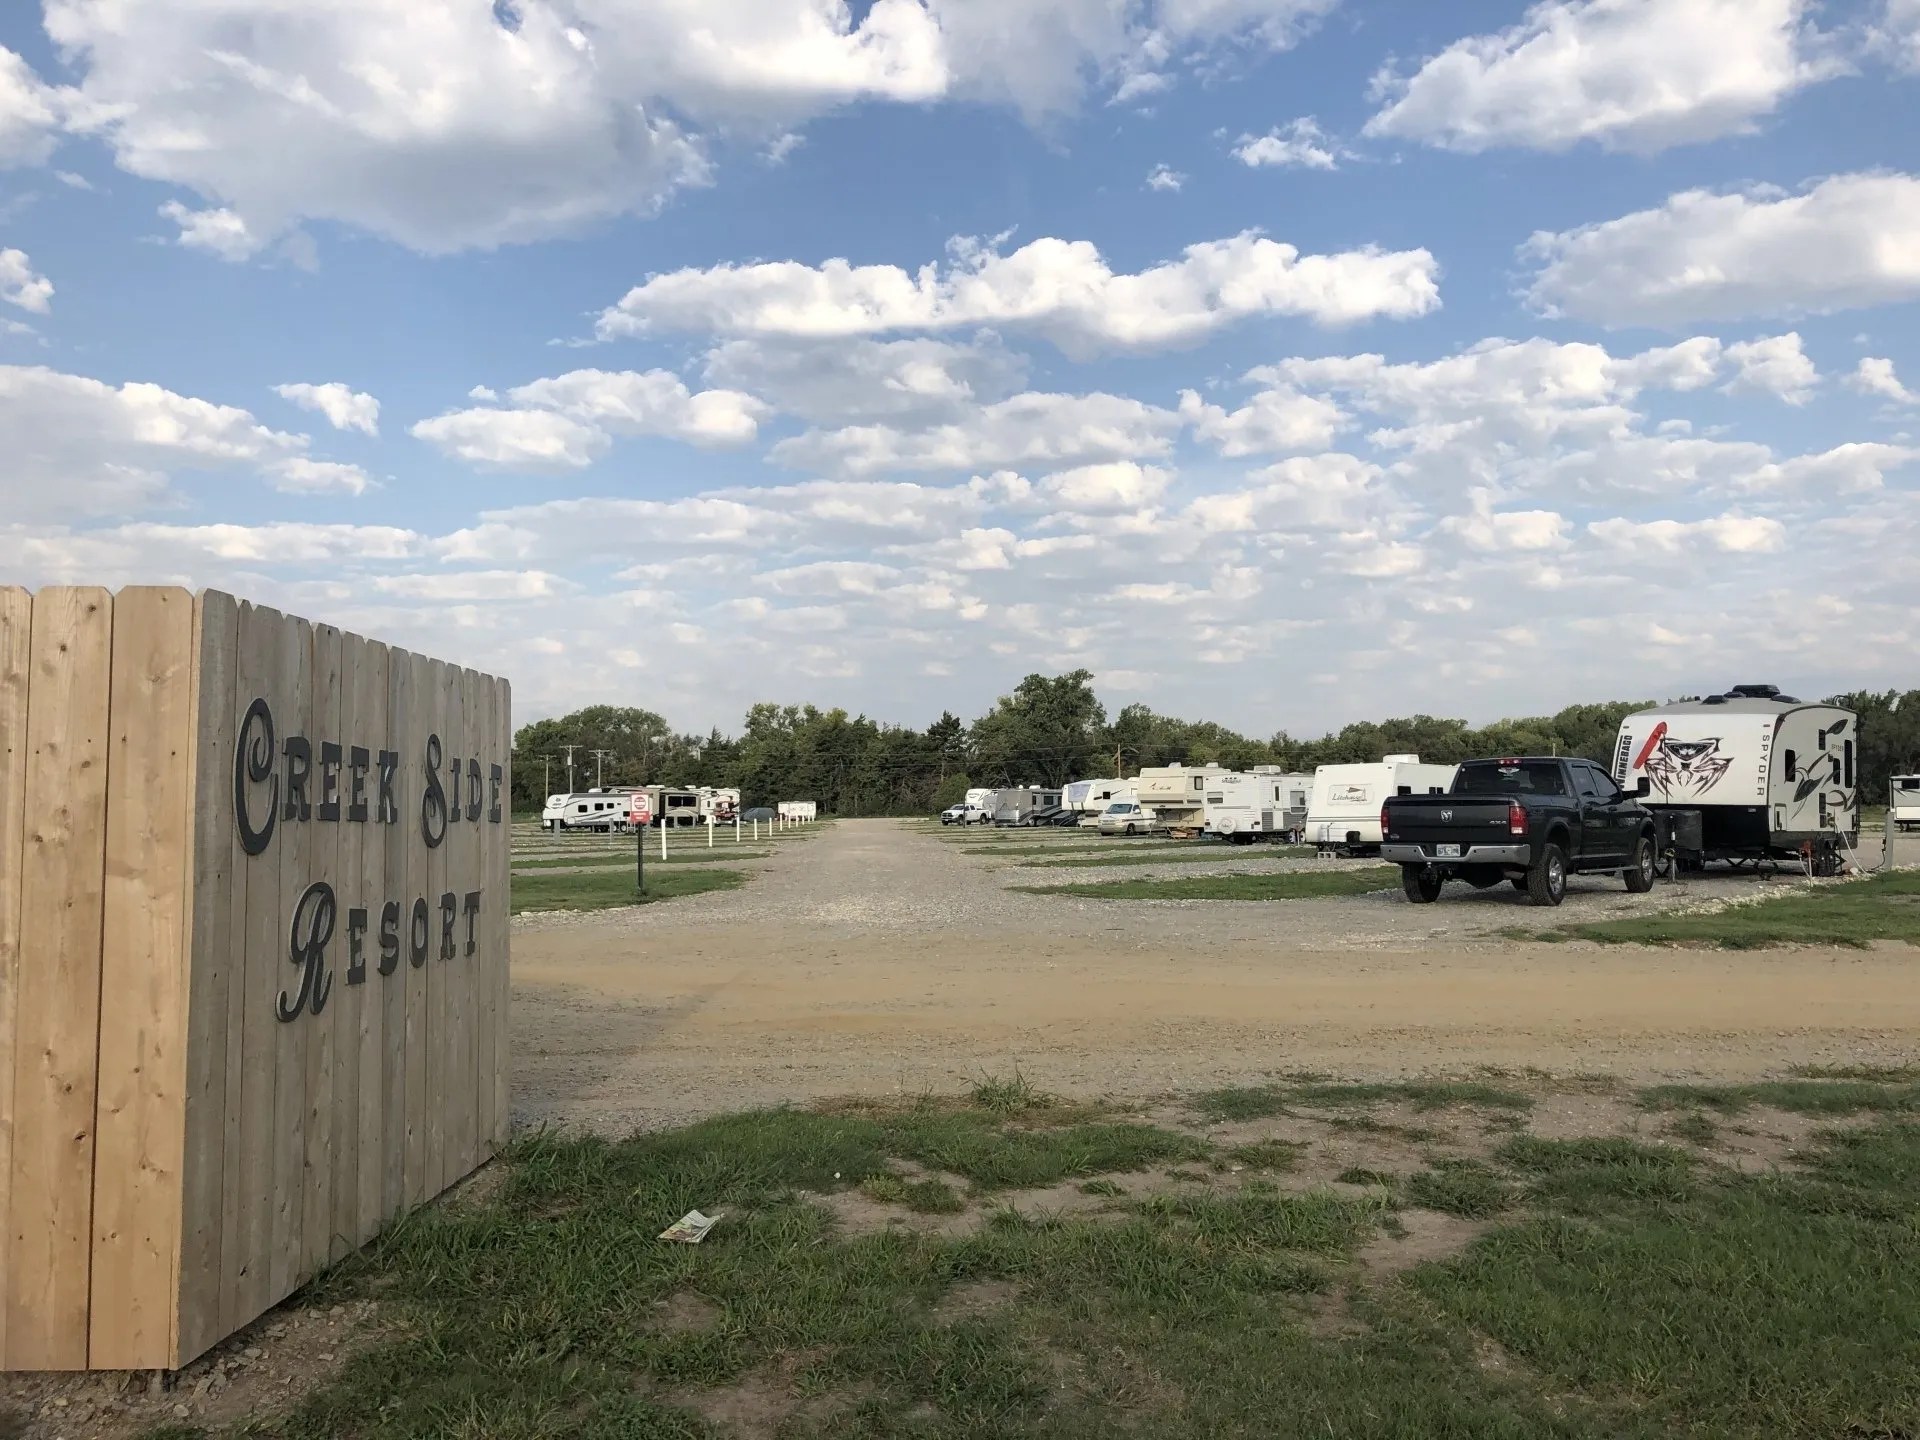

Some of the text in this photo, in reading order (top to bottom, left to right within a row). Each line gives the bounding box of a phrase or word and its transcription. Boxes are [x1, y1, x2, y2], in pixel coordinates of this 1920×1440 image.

[234, 697, 502, 855] CREEK SIDE
[1757, 734, 1771, 796] SPYDER
[275, 881, 482, 1022] RESORT
